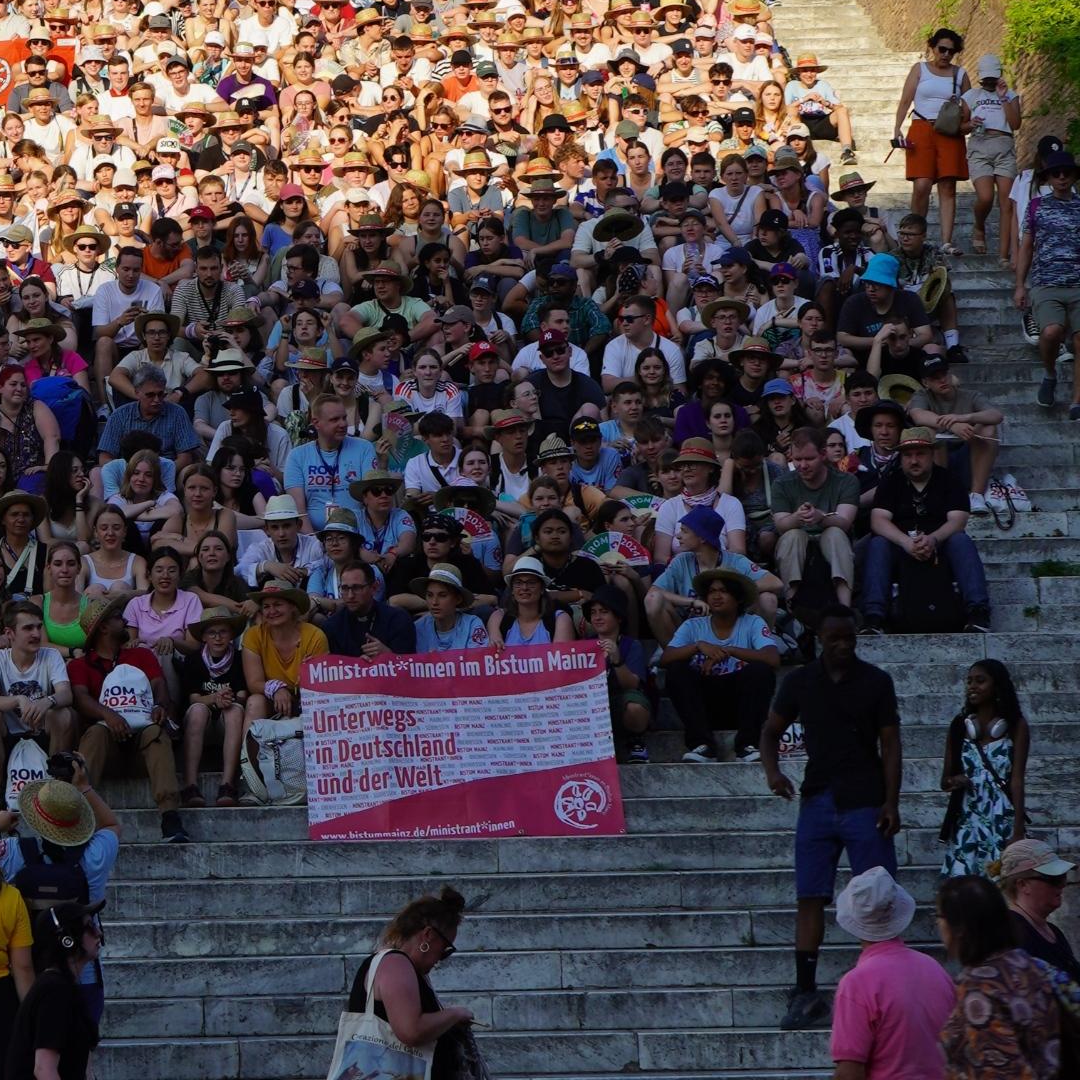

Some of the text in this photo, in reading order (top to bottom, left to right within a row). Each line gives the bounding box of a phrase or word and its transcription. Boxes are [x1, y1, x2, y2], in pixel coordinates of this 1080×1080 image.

[588, 536, 641, 557] ROM 2024
[459, 656, 480, 676] im
[484, 653, 544, 676] Bistum
[547, 648, 598, 671] Mainz
[313, 708, 417, 734] Unterwegs
[315, 740, 333, 765] in
[338, 732, 457, 763] Deutschland
[11, 768, 43, 781] ROM
[317, 764, 442, 796] und der Welt
